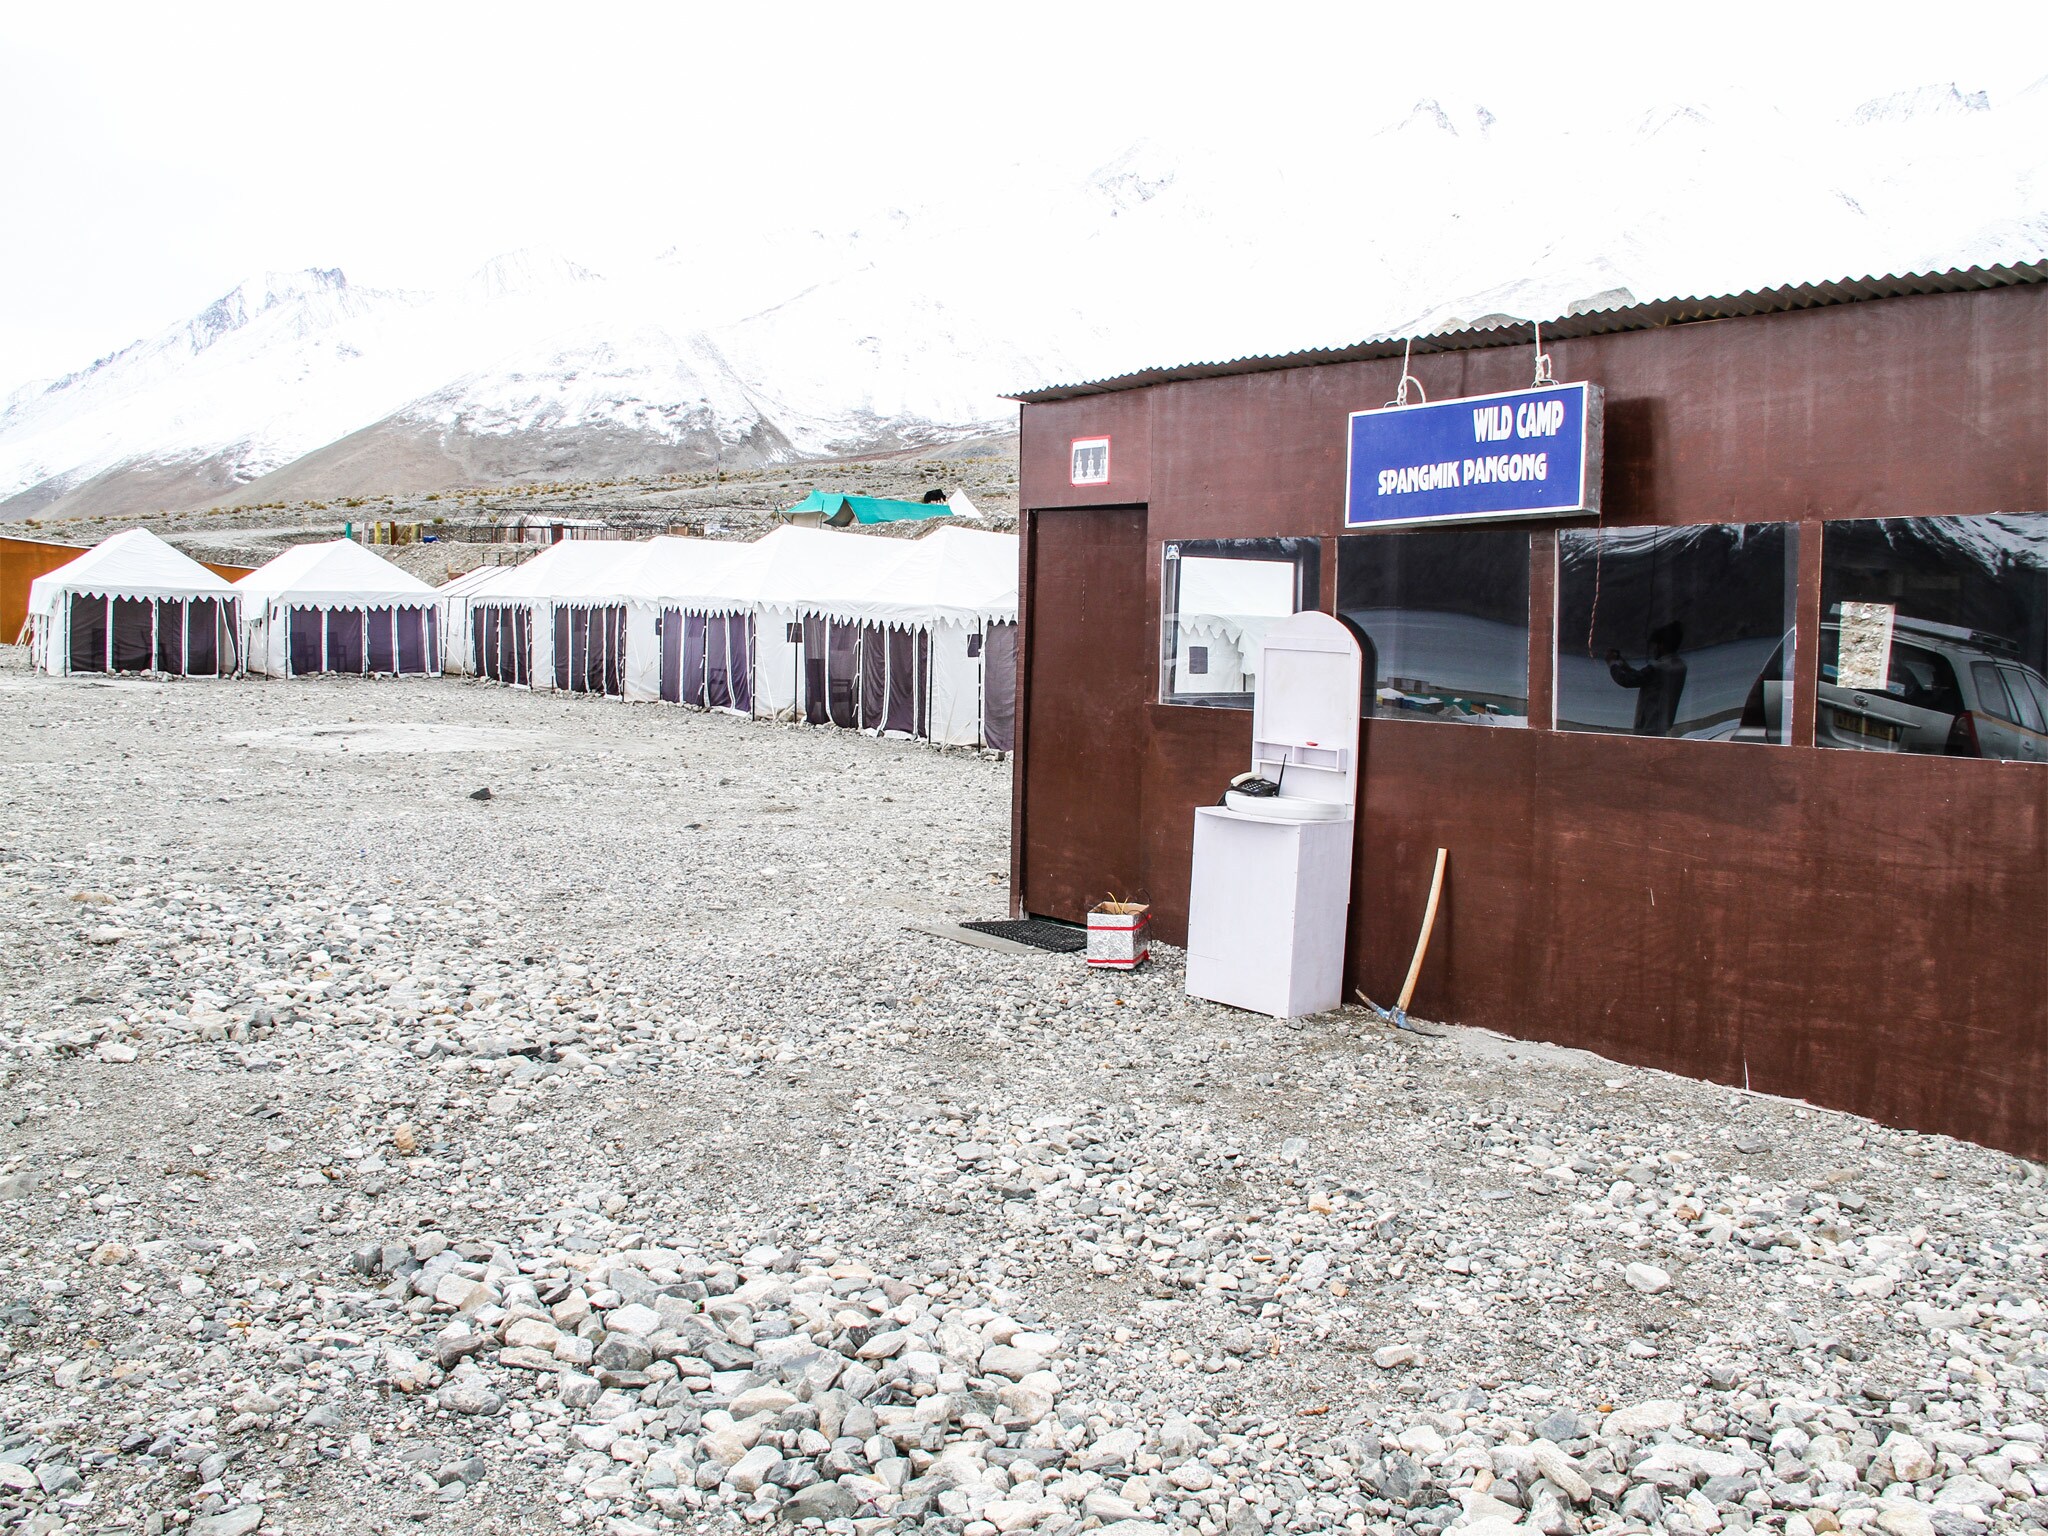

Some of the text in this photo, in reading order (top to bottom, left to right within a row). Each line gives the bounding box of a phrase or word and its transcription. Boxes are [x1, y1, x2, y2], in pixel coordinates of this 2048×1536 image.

[1473, 400, 1564, 443] WILD CAMP
[1377, 453, 1547, 495] SPANGMIK PANGONG
